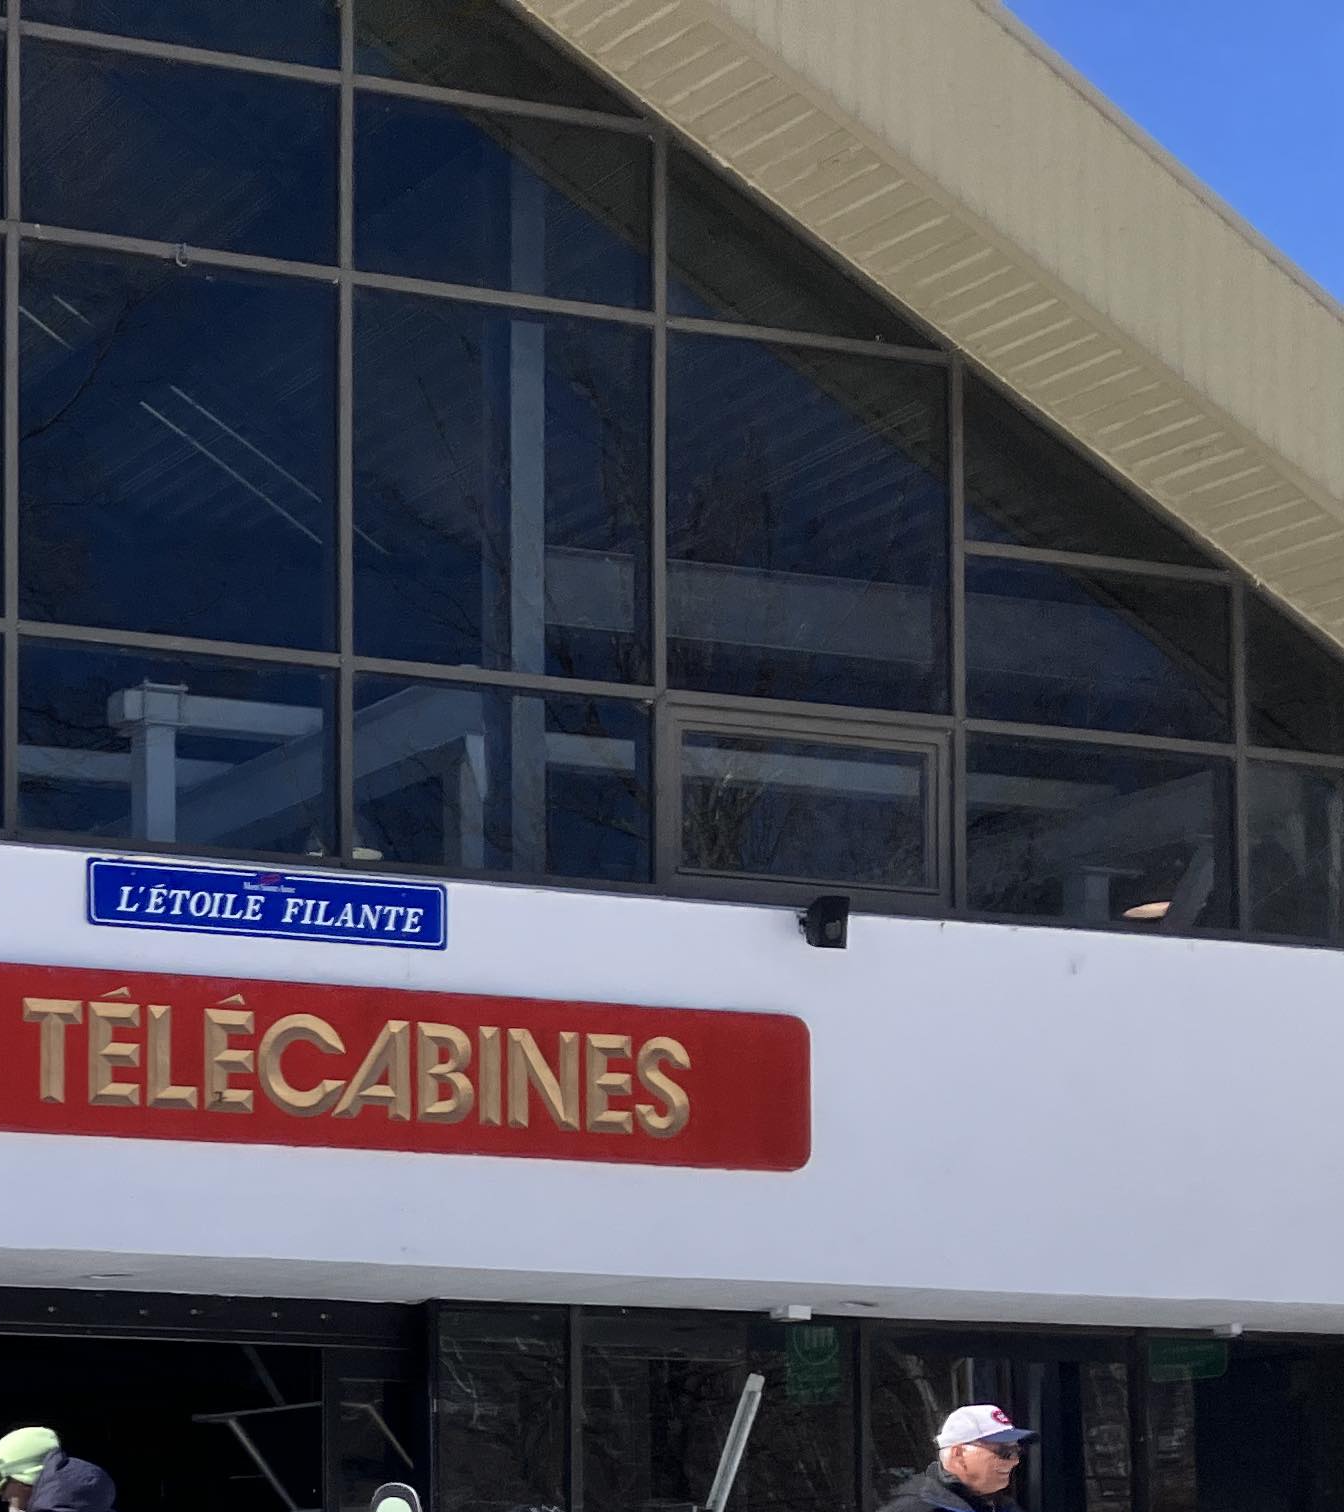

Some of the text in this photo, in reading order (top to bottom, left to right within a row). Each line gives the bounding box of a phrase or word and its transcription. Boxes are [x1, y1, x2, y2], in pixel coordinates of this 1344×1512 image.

[116, 884, 424, 934] L'ÉTOILE FILANTE
[22, 986, 692, 1138] TÉLÉCABINES
